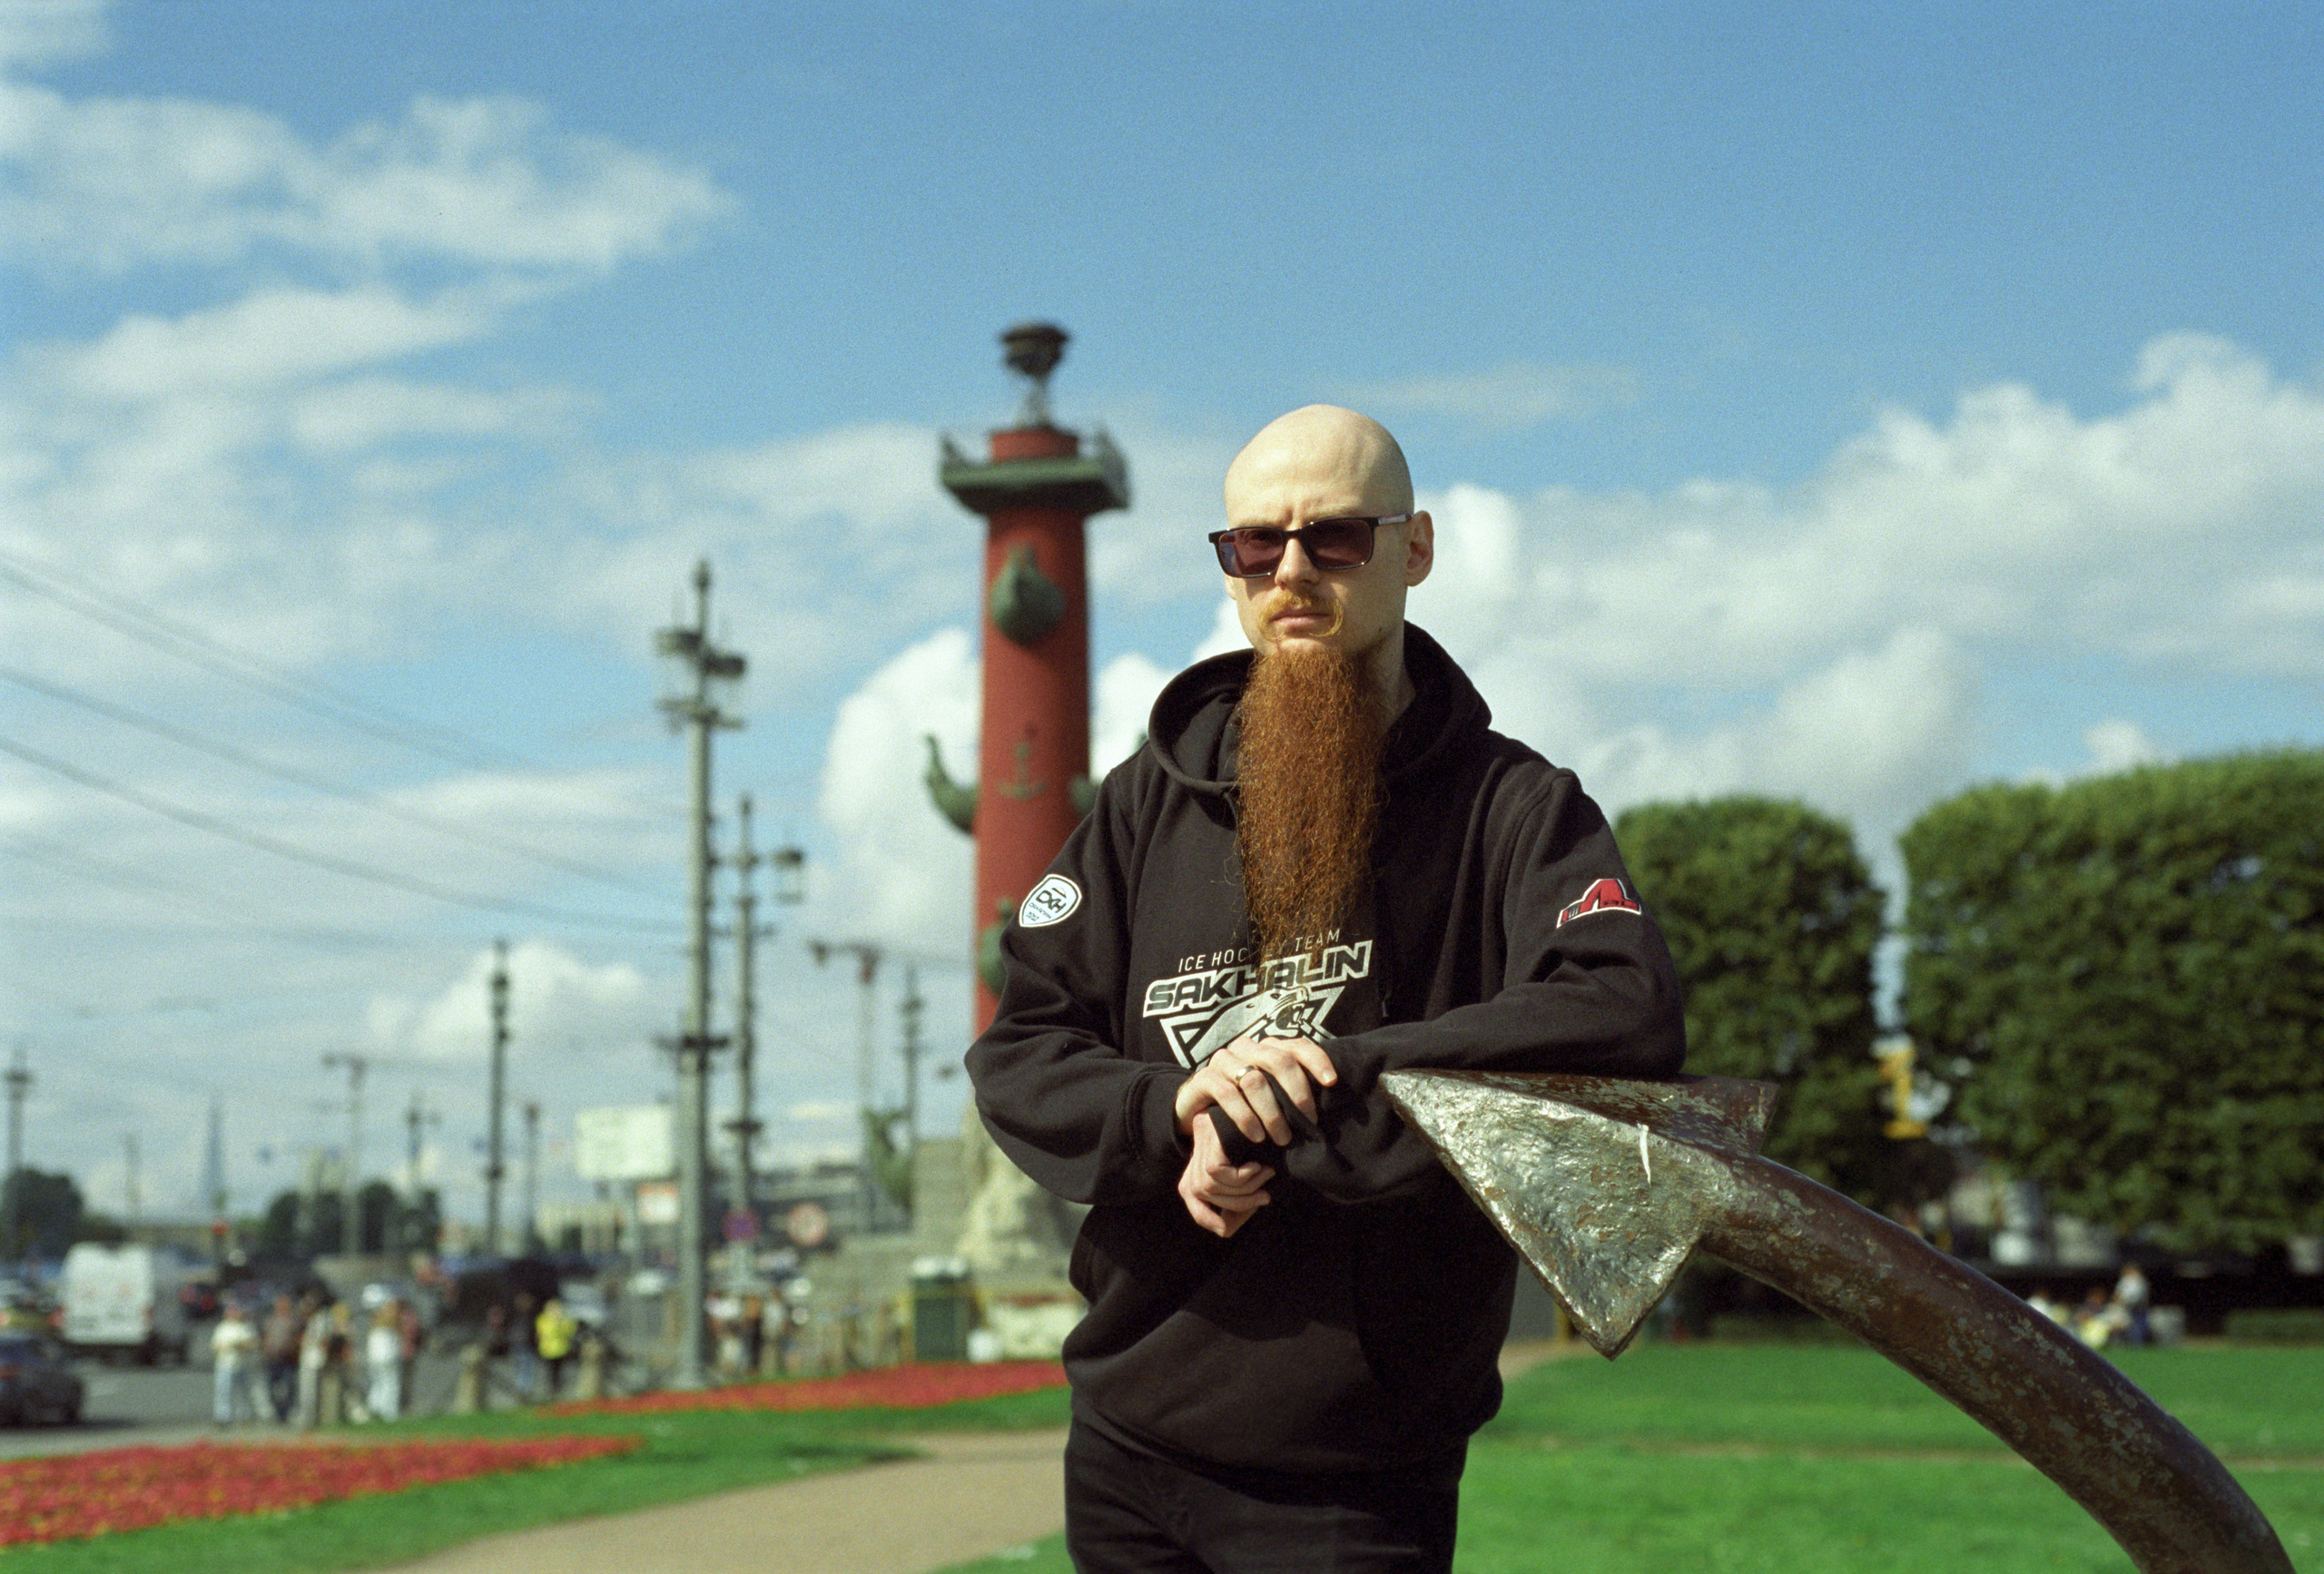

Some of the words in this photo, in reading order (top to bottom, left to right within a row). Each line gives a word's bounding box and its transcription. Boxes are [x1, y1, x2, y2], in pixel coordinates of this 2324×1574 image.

[1143, 940, 1373, 1018] SAKHALIN
[1177, 954, 1206, 973] ICE
[1295, 928, 1341, 952] TEAM
